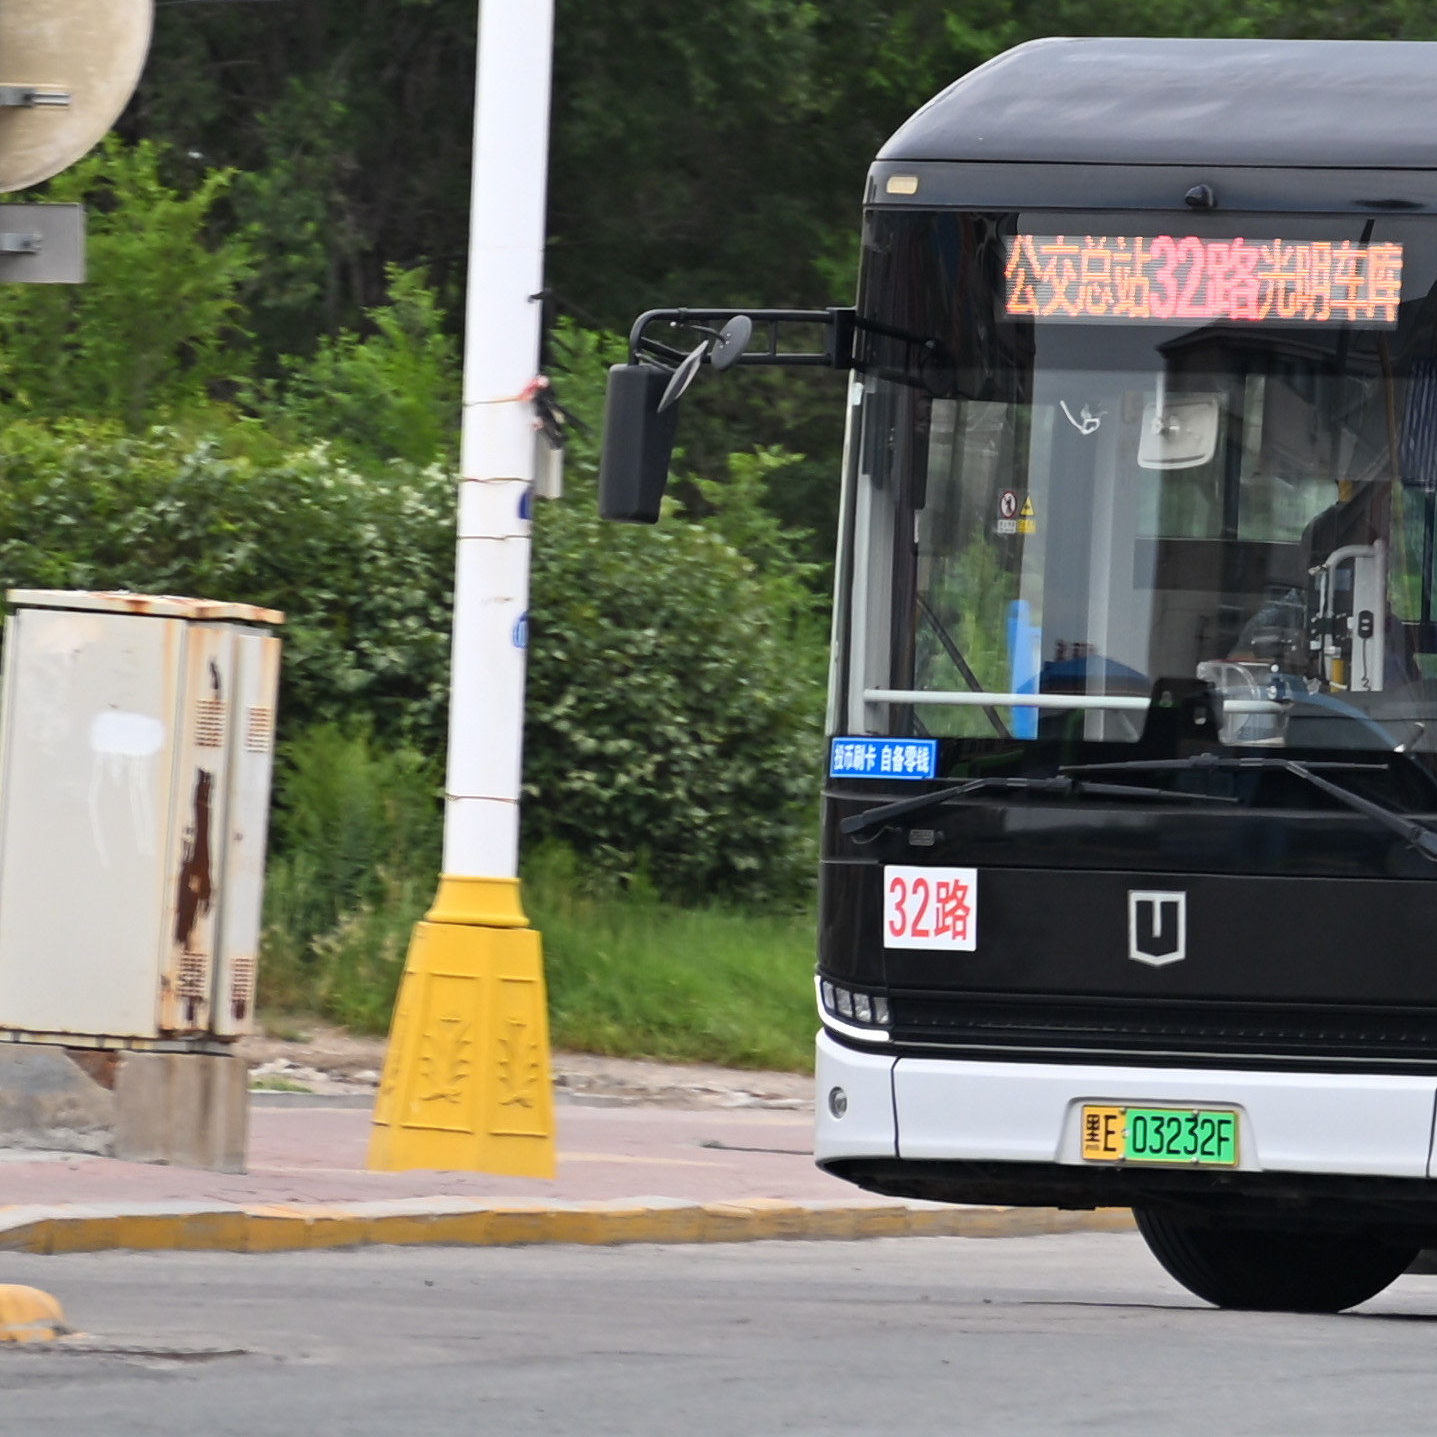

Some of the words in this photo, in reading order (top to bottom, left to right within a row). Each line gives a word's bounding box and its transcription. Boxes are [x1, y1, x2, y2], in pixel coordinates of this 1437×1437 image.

[834, 744, 877, 772] 投币刷卡
[880, 745, 930, 773] 自备零钱
[888, 876, 971, 941] 32路
